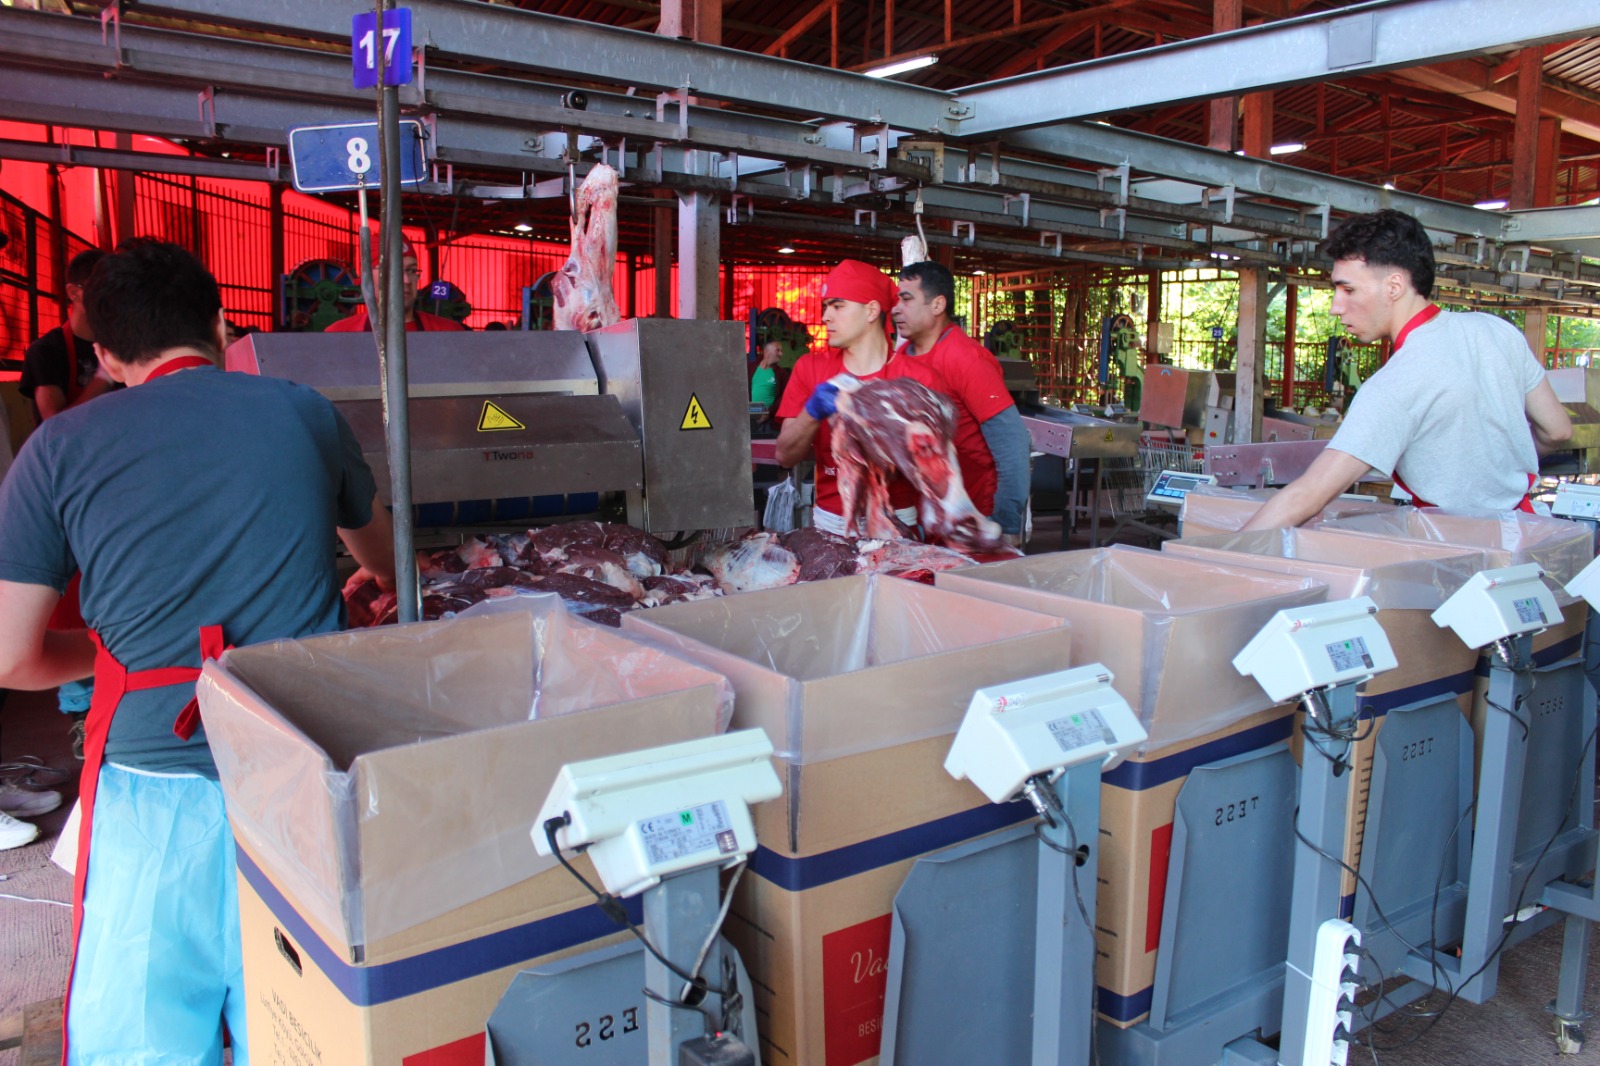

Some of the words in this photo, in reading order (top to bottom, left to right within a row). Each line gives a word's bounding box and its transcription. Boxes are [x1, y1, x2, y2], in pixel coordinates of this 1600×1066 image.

[359, 27, 400, 69] 17
[346, 137, 371, 174] 8
[433, 285, 447, 296] 23
[682, 813, 690, 823] M
[850, 948, 889, 984] Va
